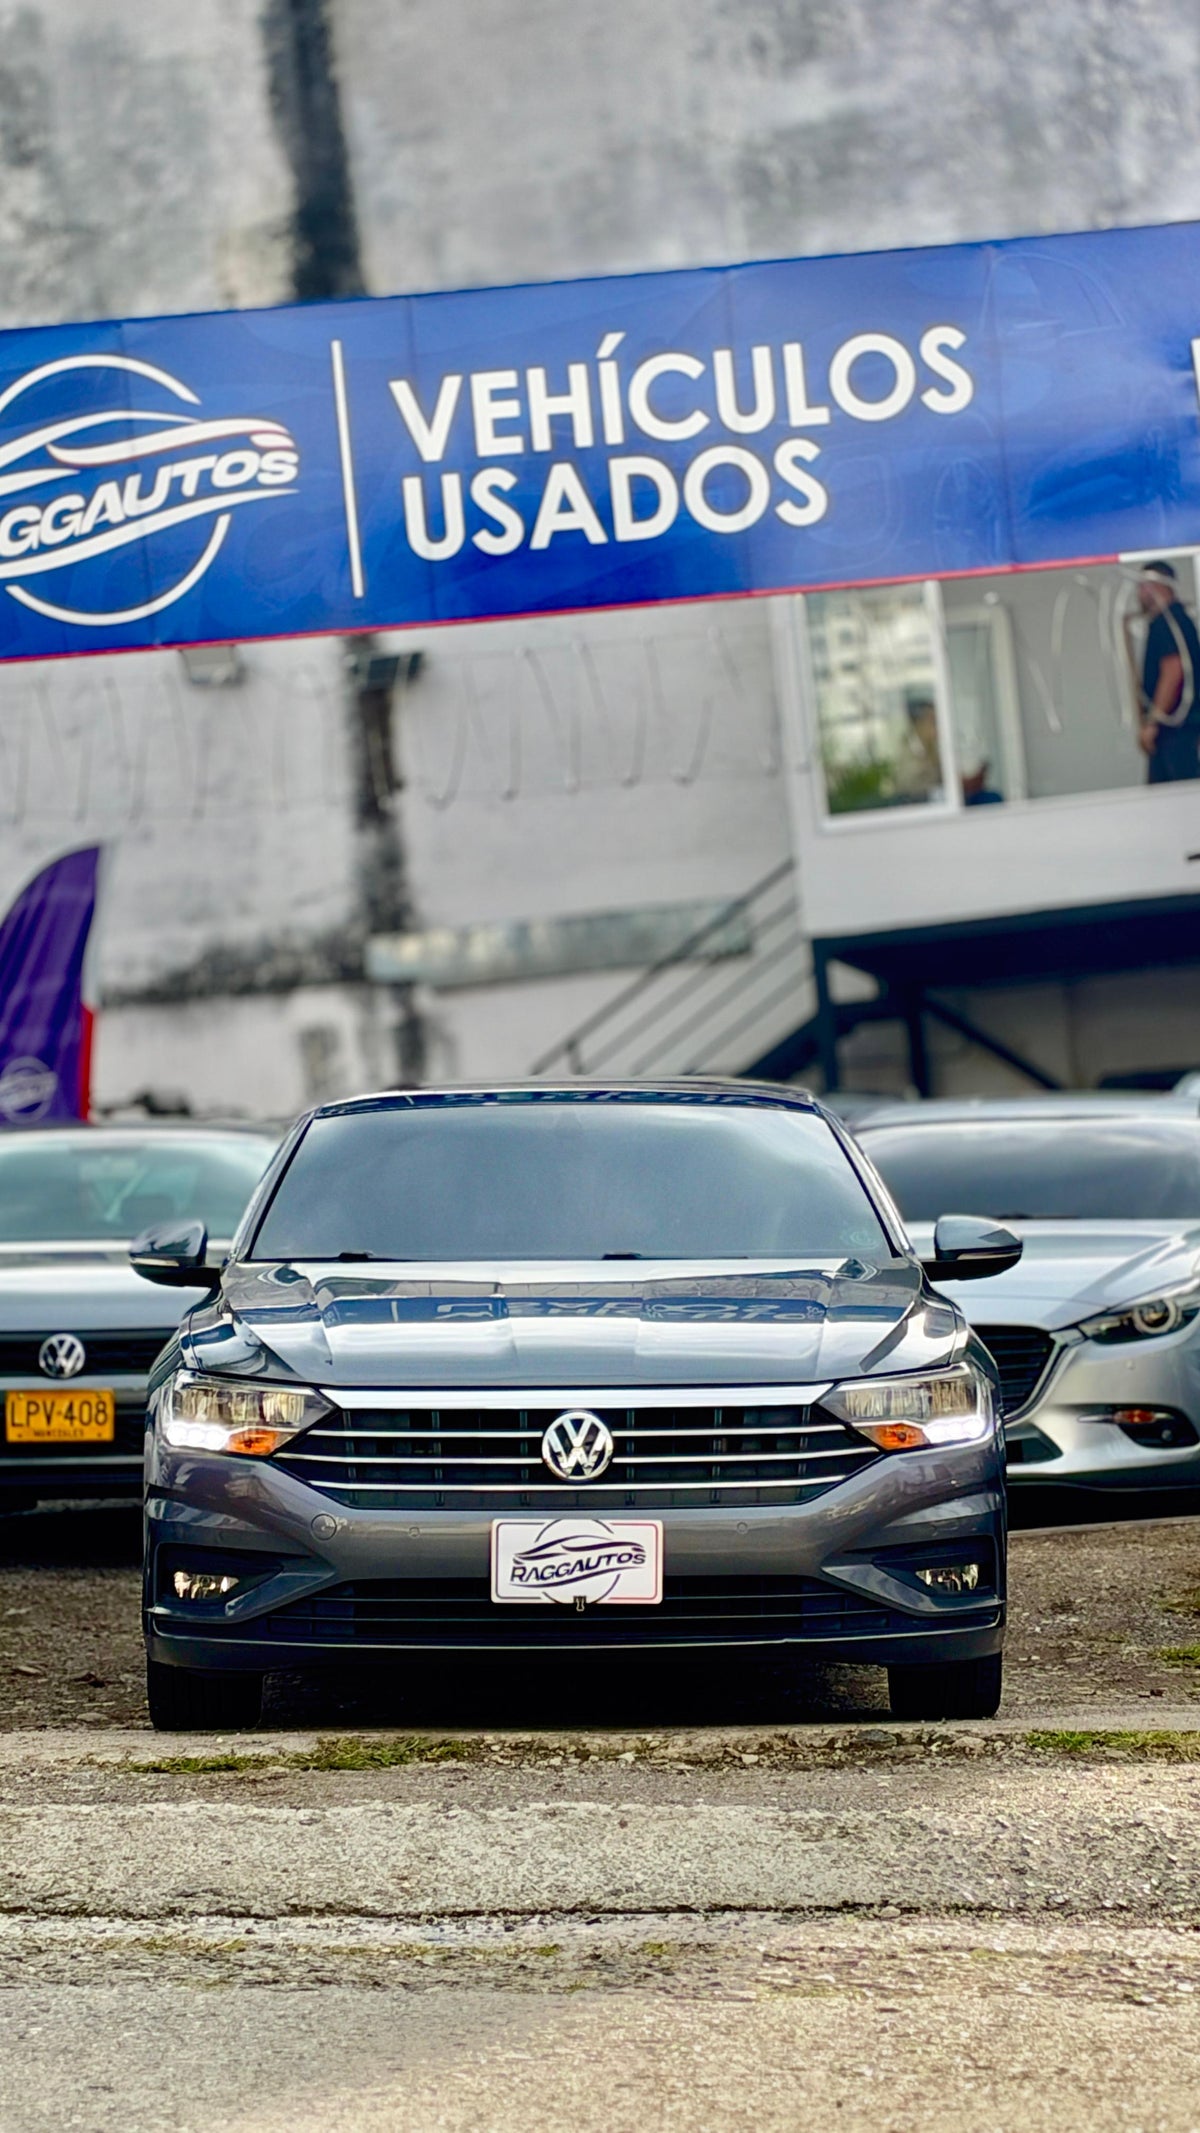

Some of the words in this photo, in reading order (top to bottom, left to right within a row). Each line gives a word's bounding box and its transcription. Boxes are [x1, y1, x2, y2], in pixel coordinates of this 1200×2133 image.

[389, 325, 974, 462] VEHÍCULOS
[0, 450, 299, 557] GGAUTOS
[402, 437, 829, 562] USADOS
[510, 1553, 647, 1583] RAGGAUTOS
